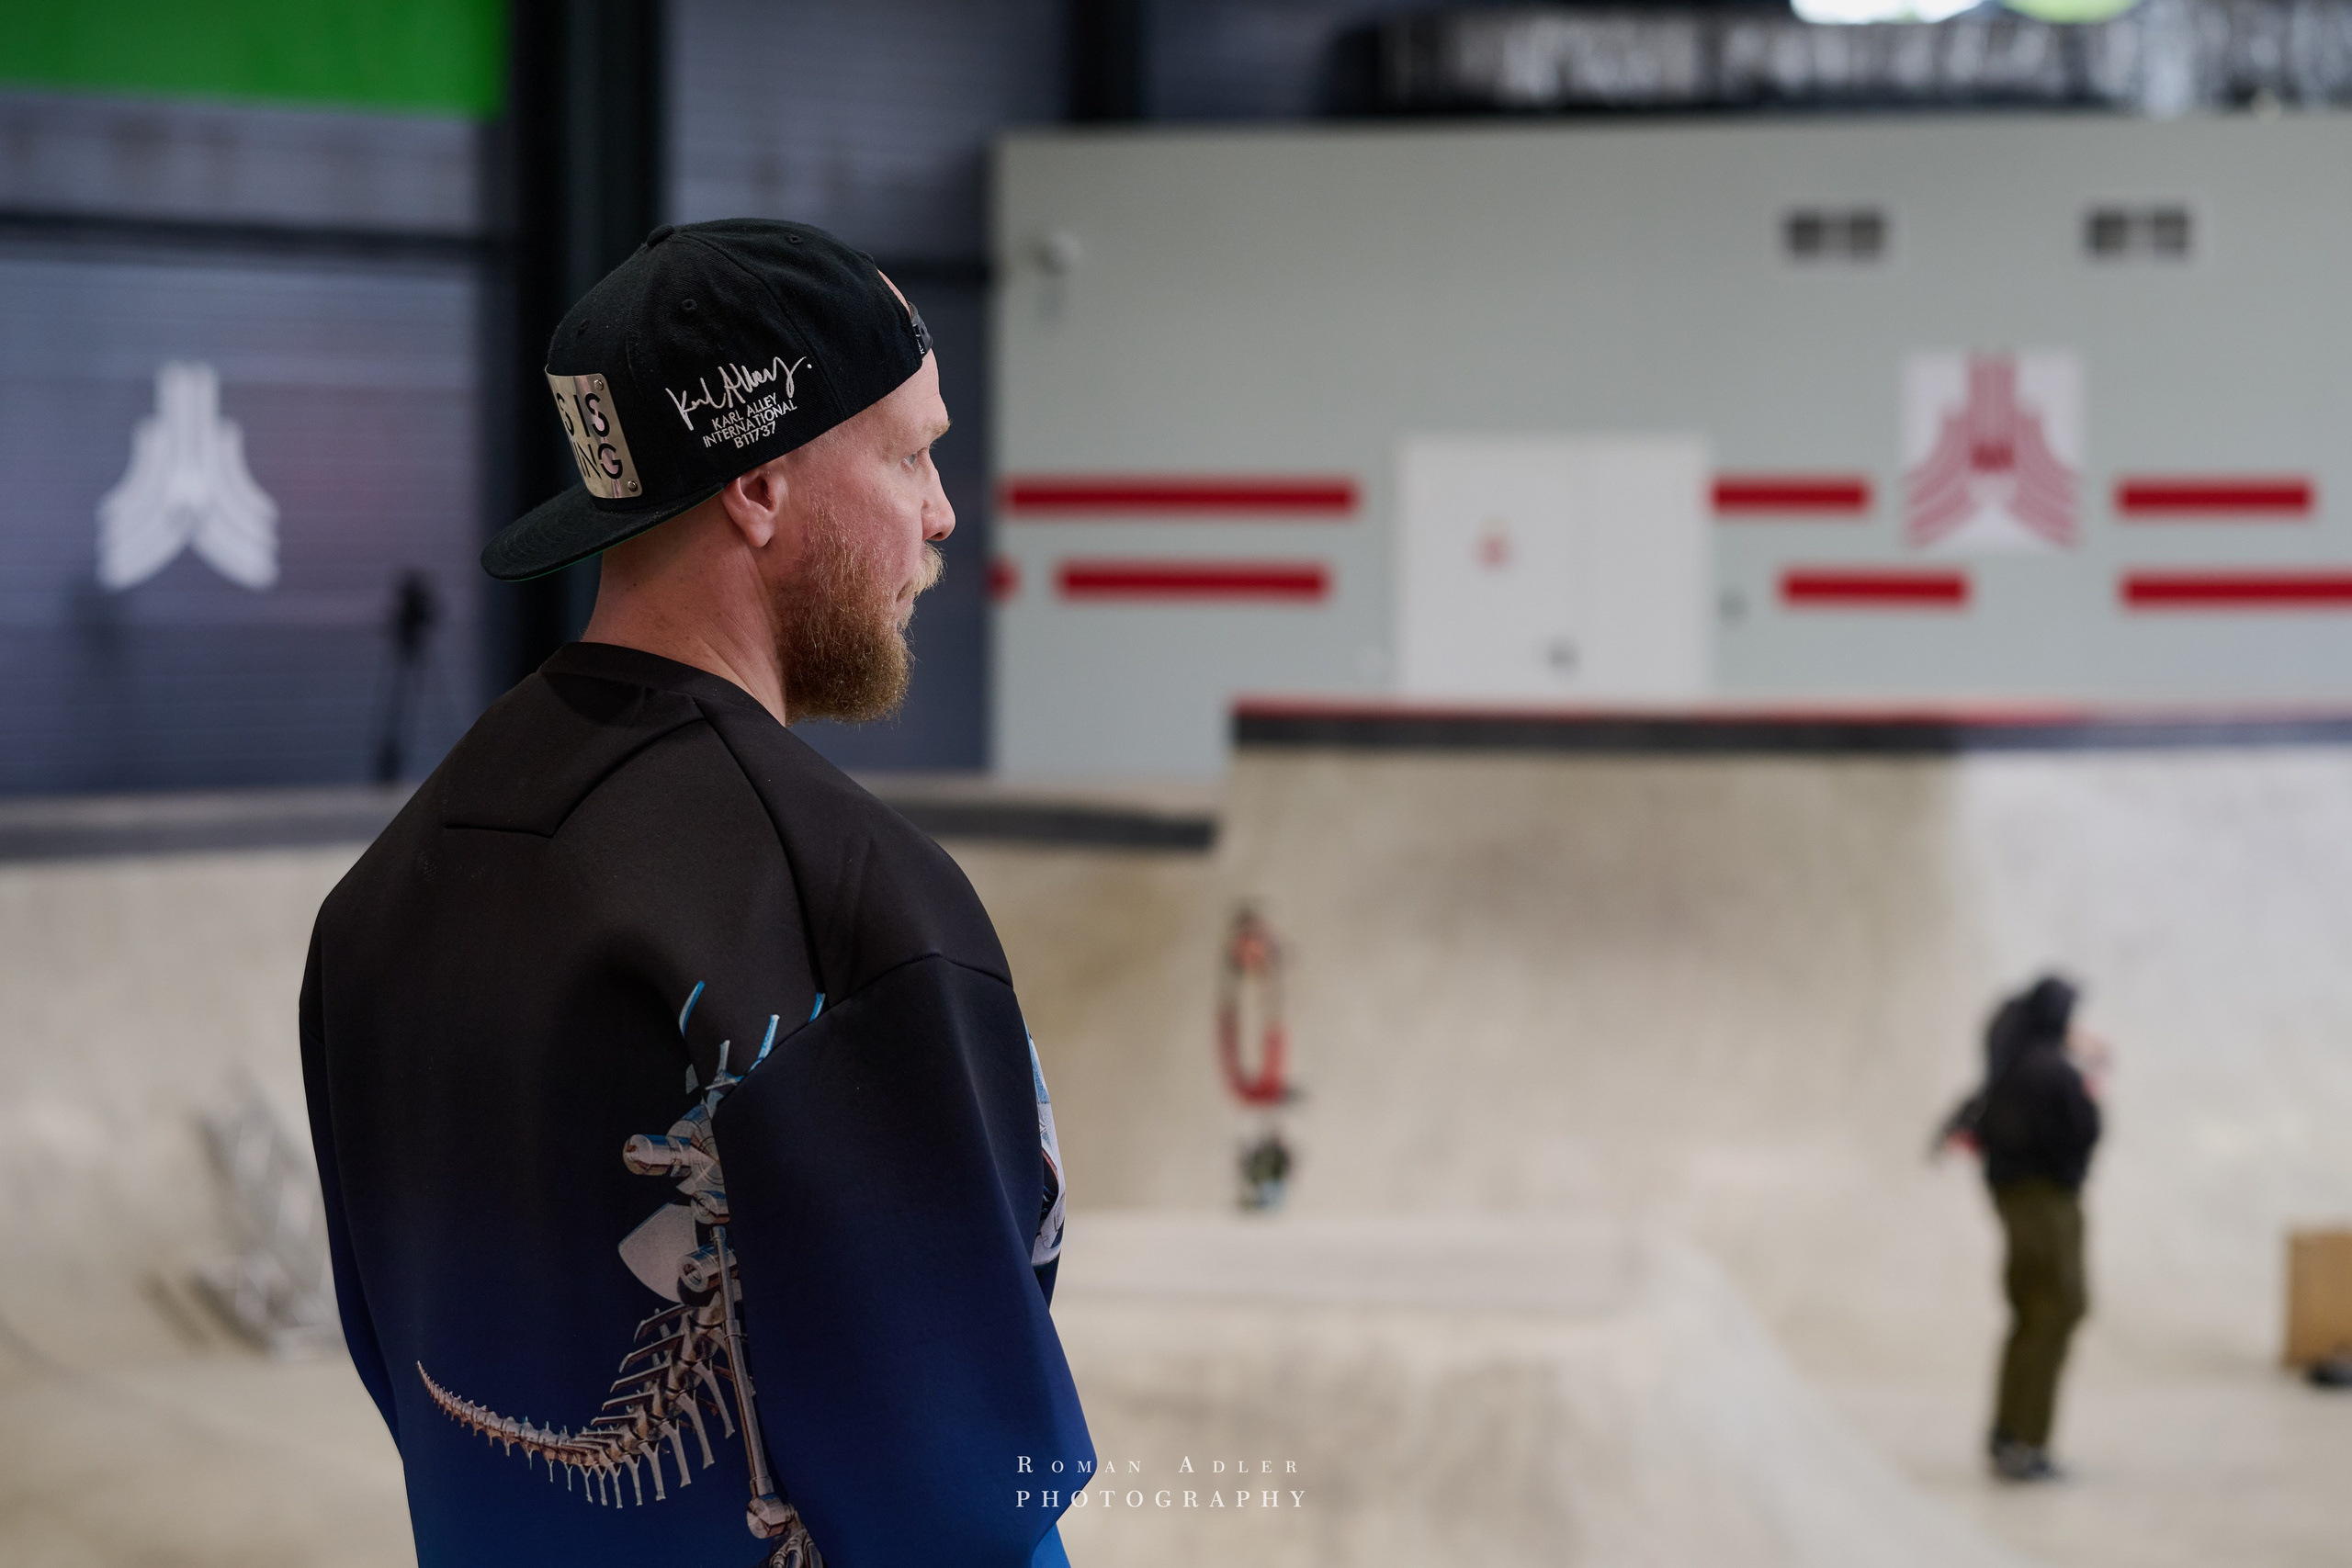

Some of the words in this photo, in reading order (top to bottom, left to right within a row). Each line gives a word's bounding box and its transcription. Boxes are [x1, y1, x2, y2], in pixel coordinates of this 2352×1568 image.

[573, 392, 610, 437] IS
[703, 400, 797, 448] INTERNATIONAL
[711, 410, 744, 431] KARL
[747, 392, 777, 415] ALLEY
[733, 421, 776, 449] B11737
